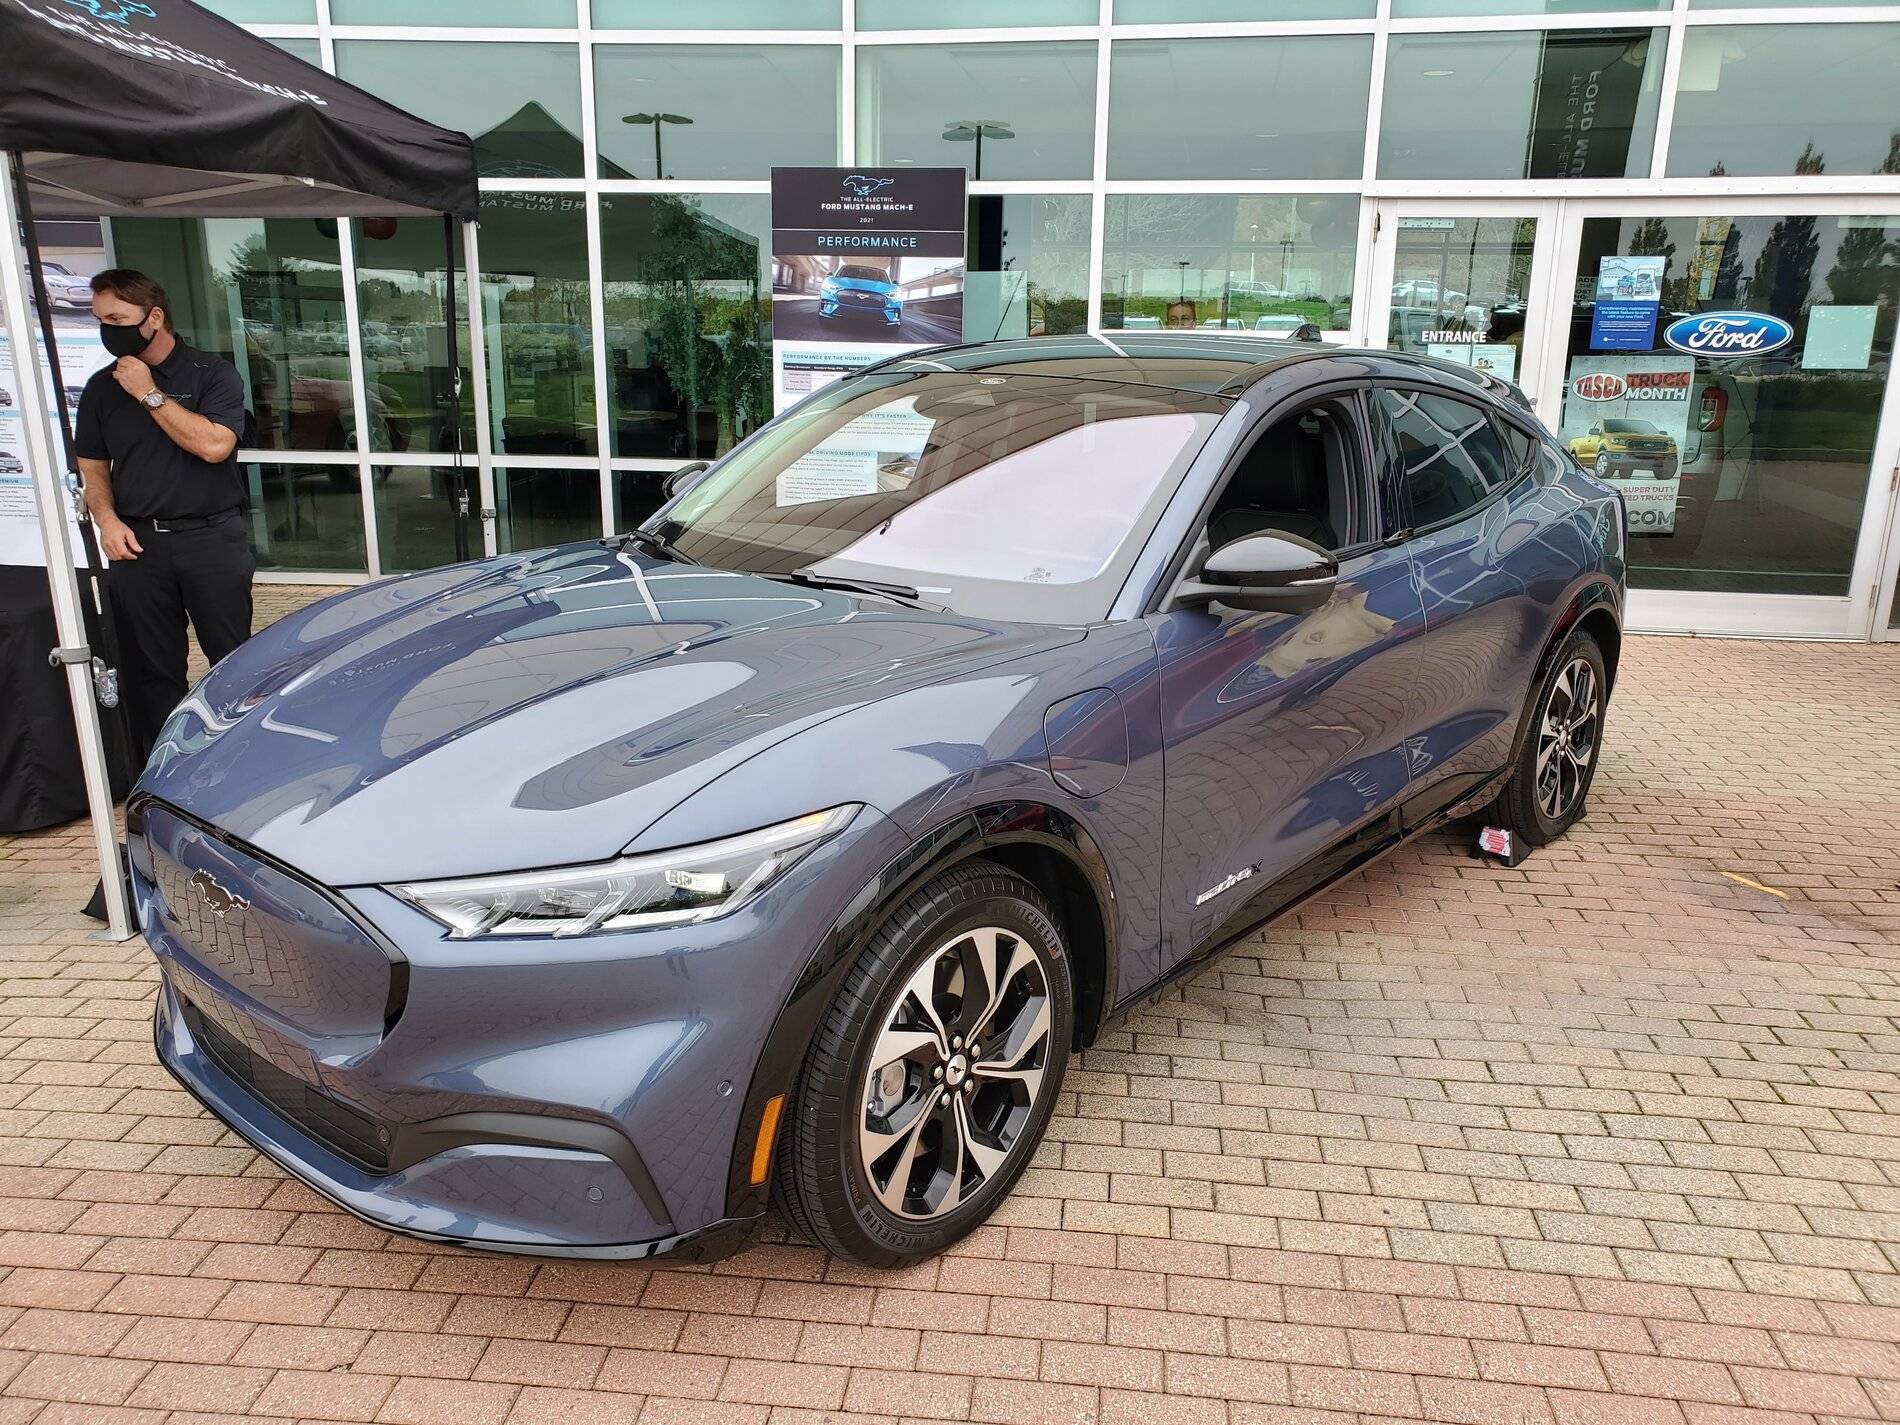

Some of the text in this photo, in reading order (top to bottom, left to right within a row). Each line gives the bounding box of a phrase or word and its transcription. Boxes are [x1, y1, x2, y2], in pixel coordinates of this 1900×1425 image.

[843, 203, 881, 211] MUSTANG
[817, 236, 917, 248] PERFORMANCE
[1421, 330, 1488, 343] ENTRANCE
[1688, 318, 1769, 348] Ford
[1576, 375, 1686, 400] TASCA MONTH
[1627, 373, 1688, 388] TRUCK
